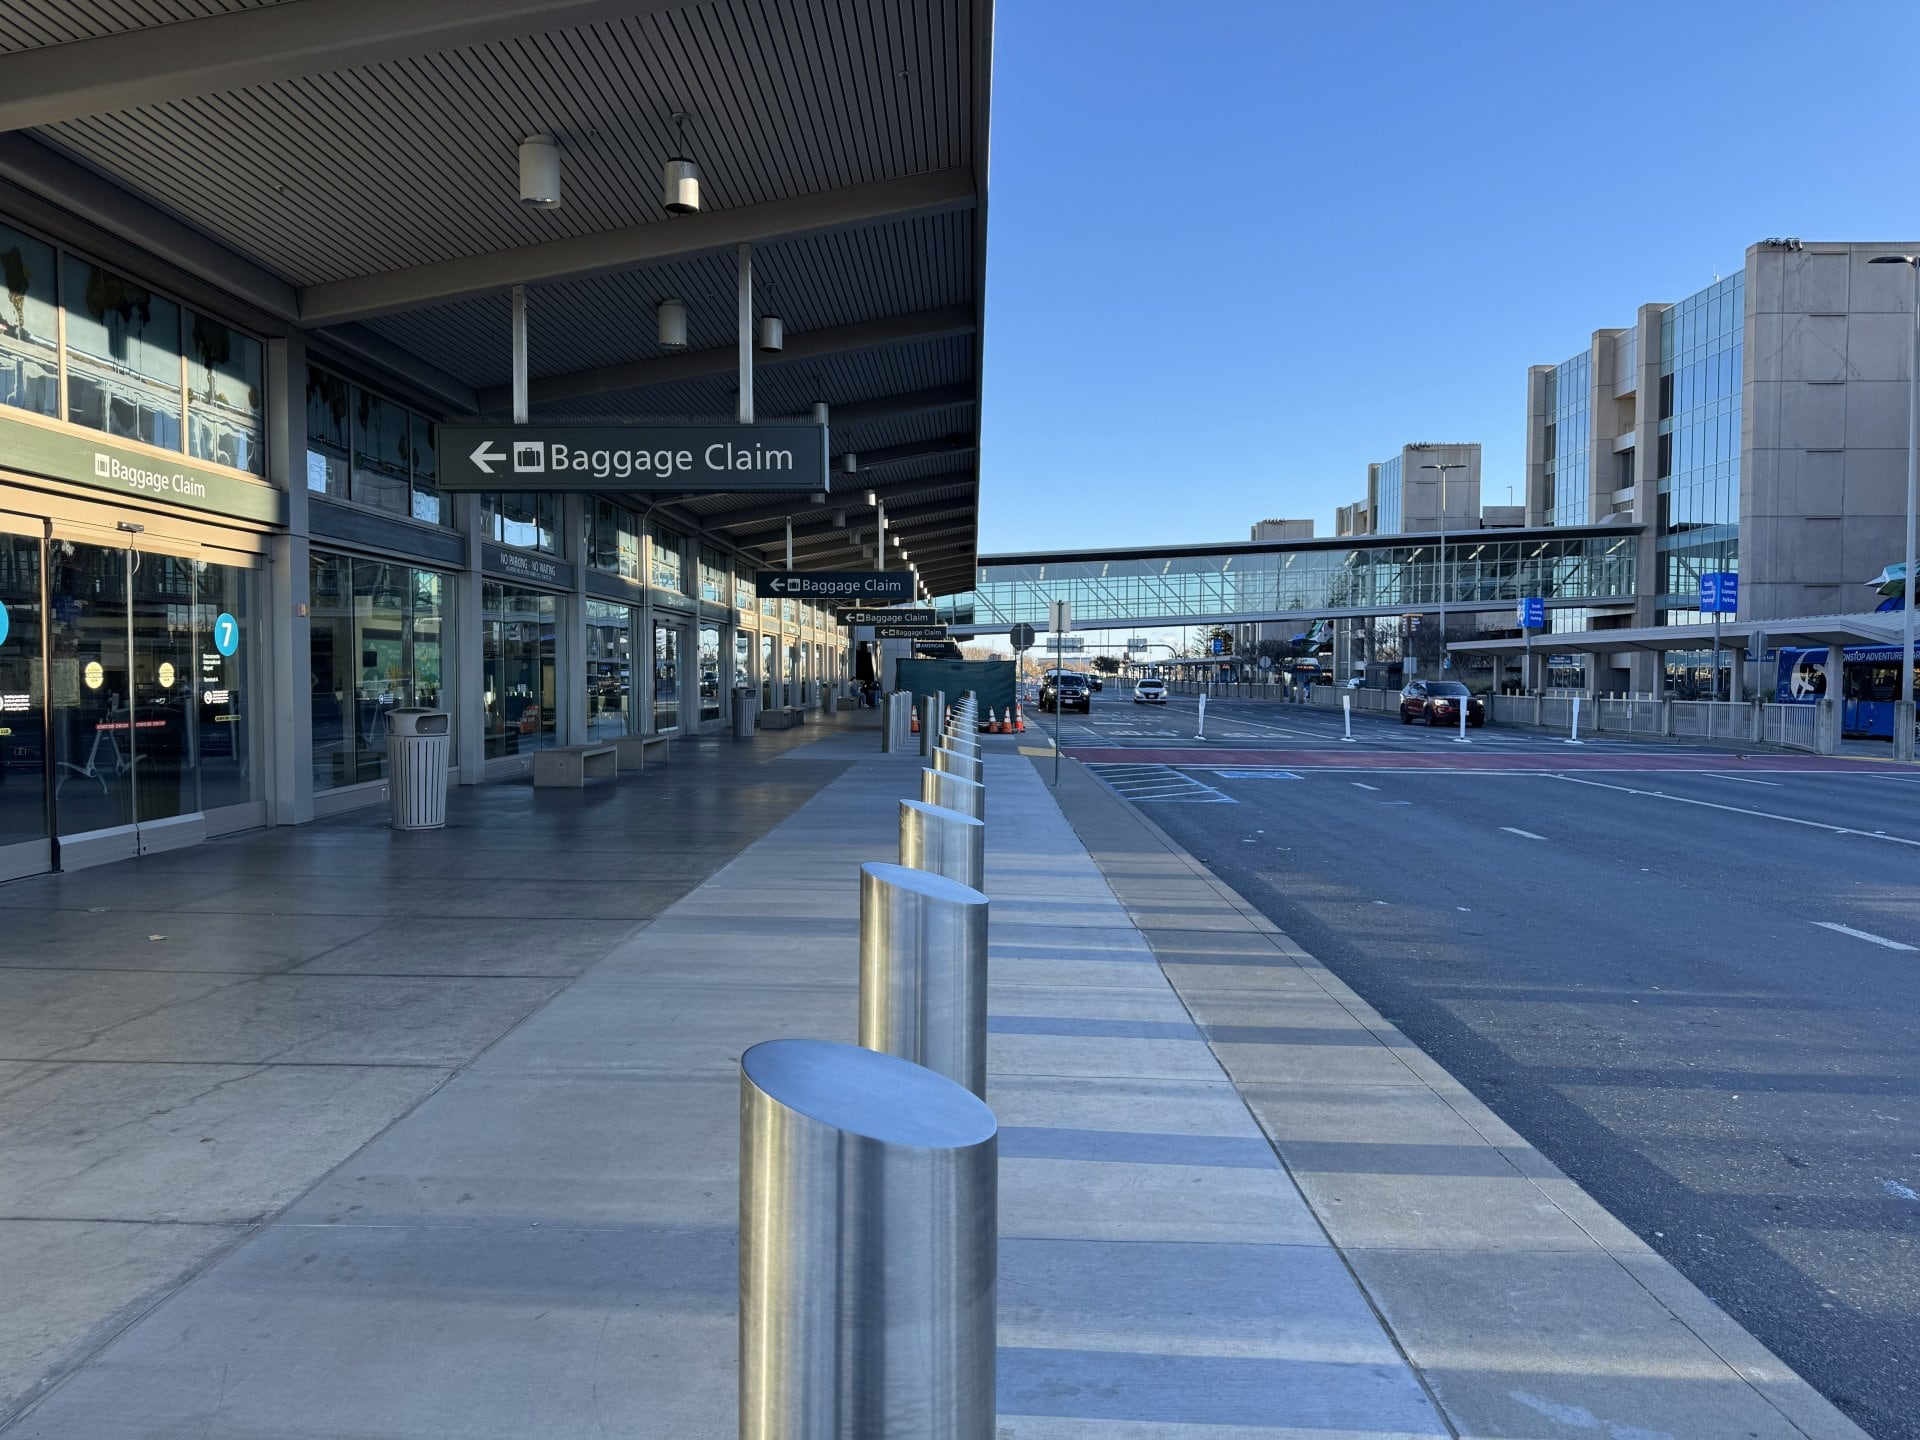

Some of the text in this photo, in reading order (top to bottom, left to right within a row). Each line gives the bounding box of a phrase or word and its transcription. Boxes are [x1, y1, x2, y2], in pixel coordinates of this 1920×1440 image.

[551, 442, 793, 478] Baggage Claim
[111, 458, 205, 498] Baggage Claim
[500, 553, 508, 565] NO
[509, 554, 528, 569] PARKING
[531, 561, 539, 572] NO
[540, 562, 556, 576] WAITING
[802, 579, 901, 594] Baggage Claim
[865, 613, 928, 623] Baggage Claim
[221, 622, 232, 647] 7
[895, 628, 942, 637] Baggage Claim
[1842, 653, 1866, 662] ONSTOP
